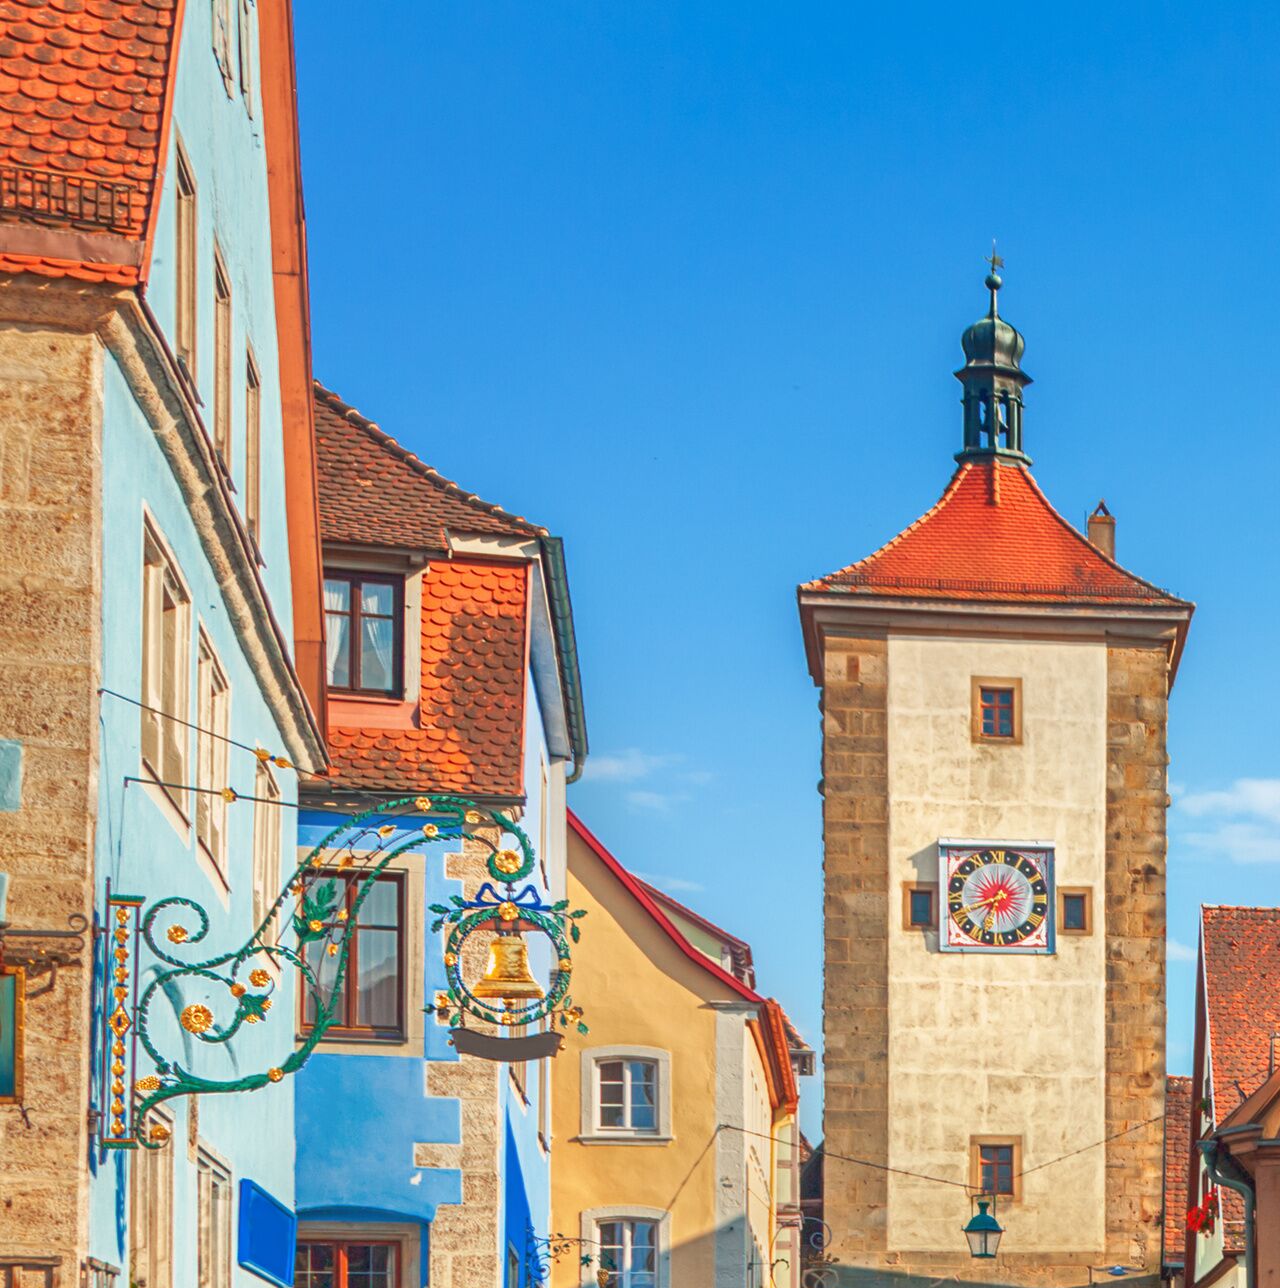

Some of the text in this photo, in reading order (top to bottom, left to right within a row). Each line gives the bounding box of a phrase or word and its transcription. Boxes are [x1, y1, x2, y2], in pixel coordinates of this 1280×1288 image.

[969, 854, 985, 868] XI
[989, 850, 1006, 864] XII
[1015, 856, 1025, 869] I
[1028, 872, 1042, 884] II
[948, 891, 962, 903] IX
[1034, 894, 1047, 904] III
